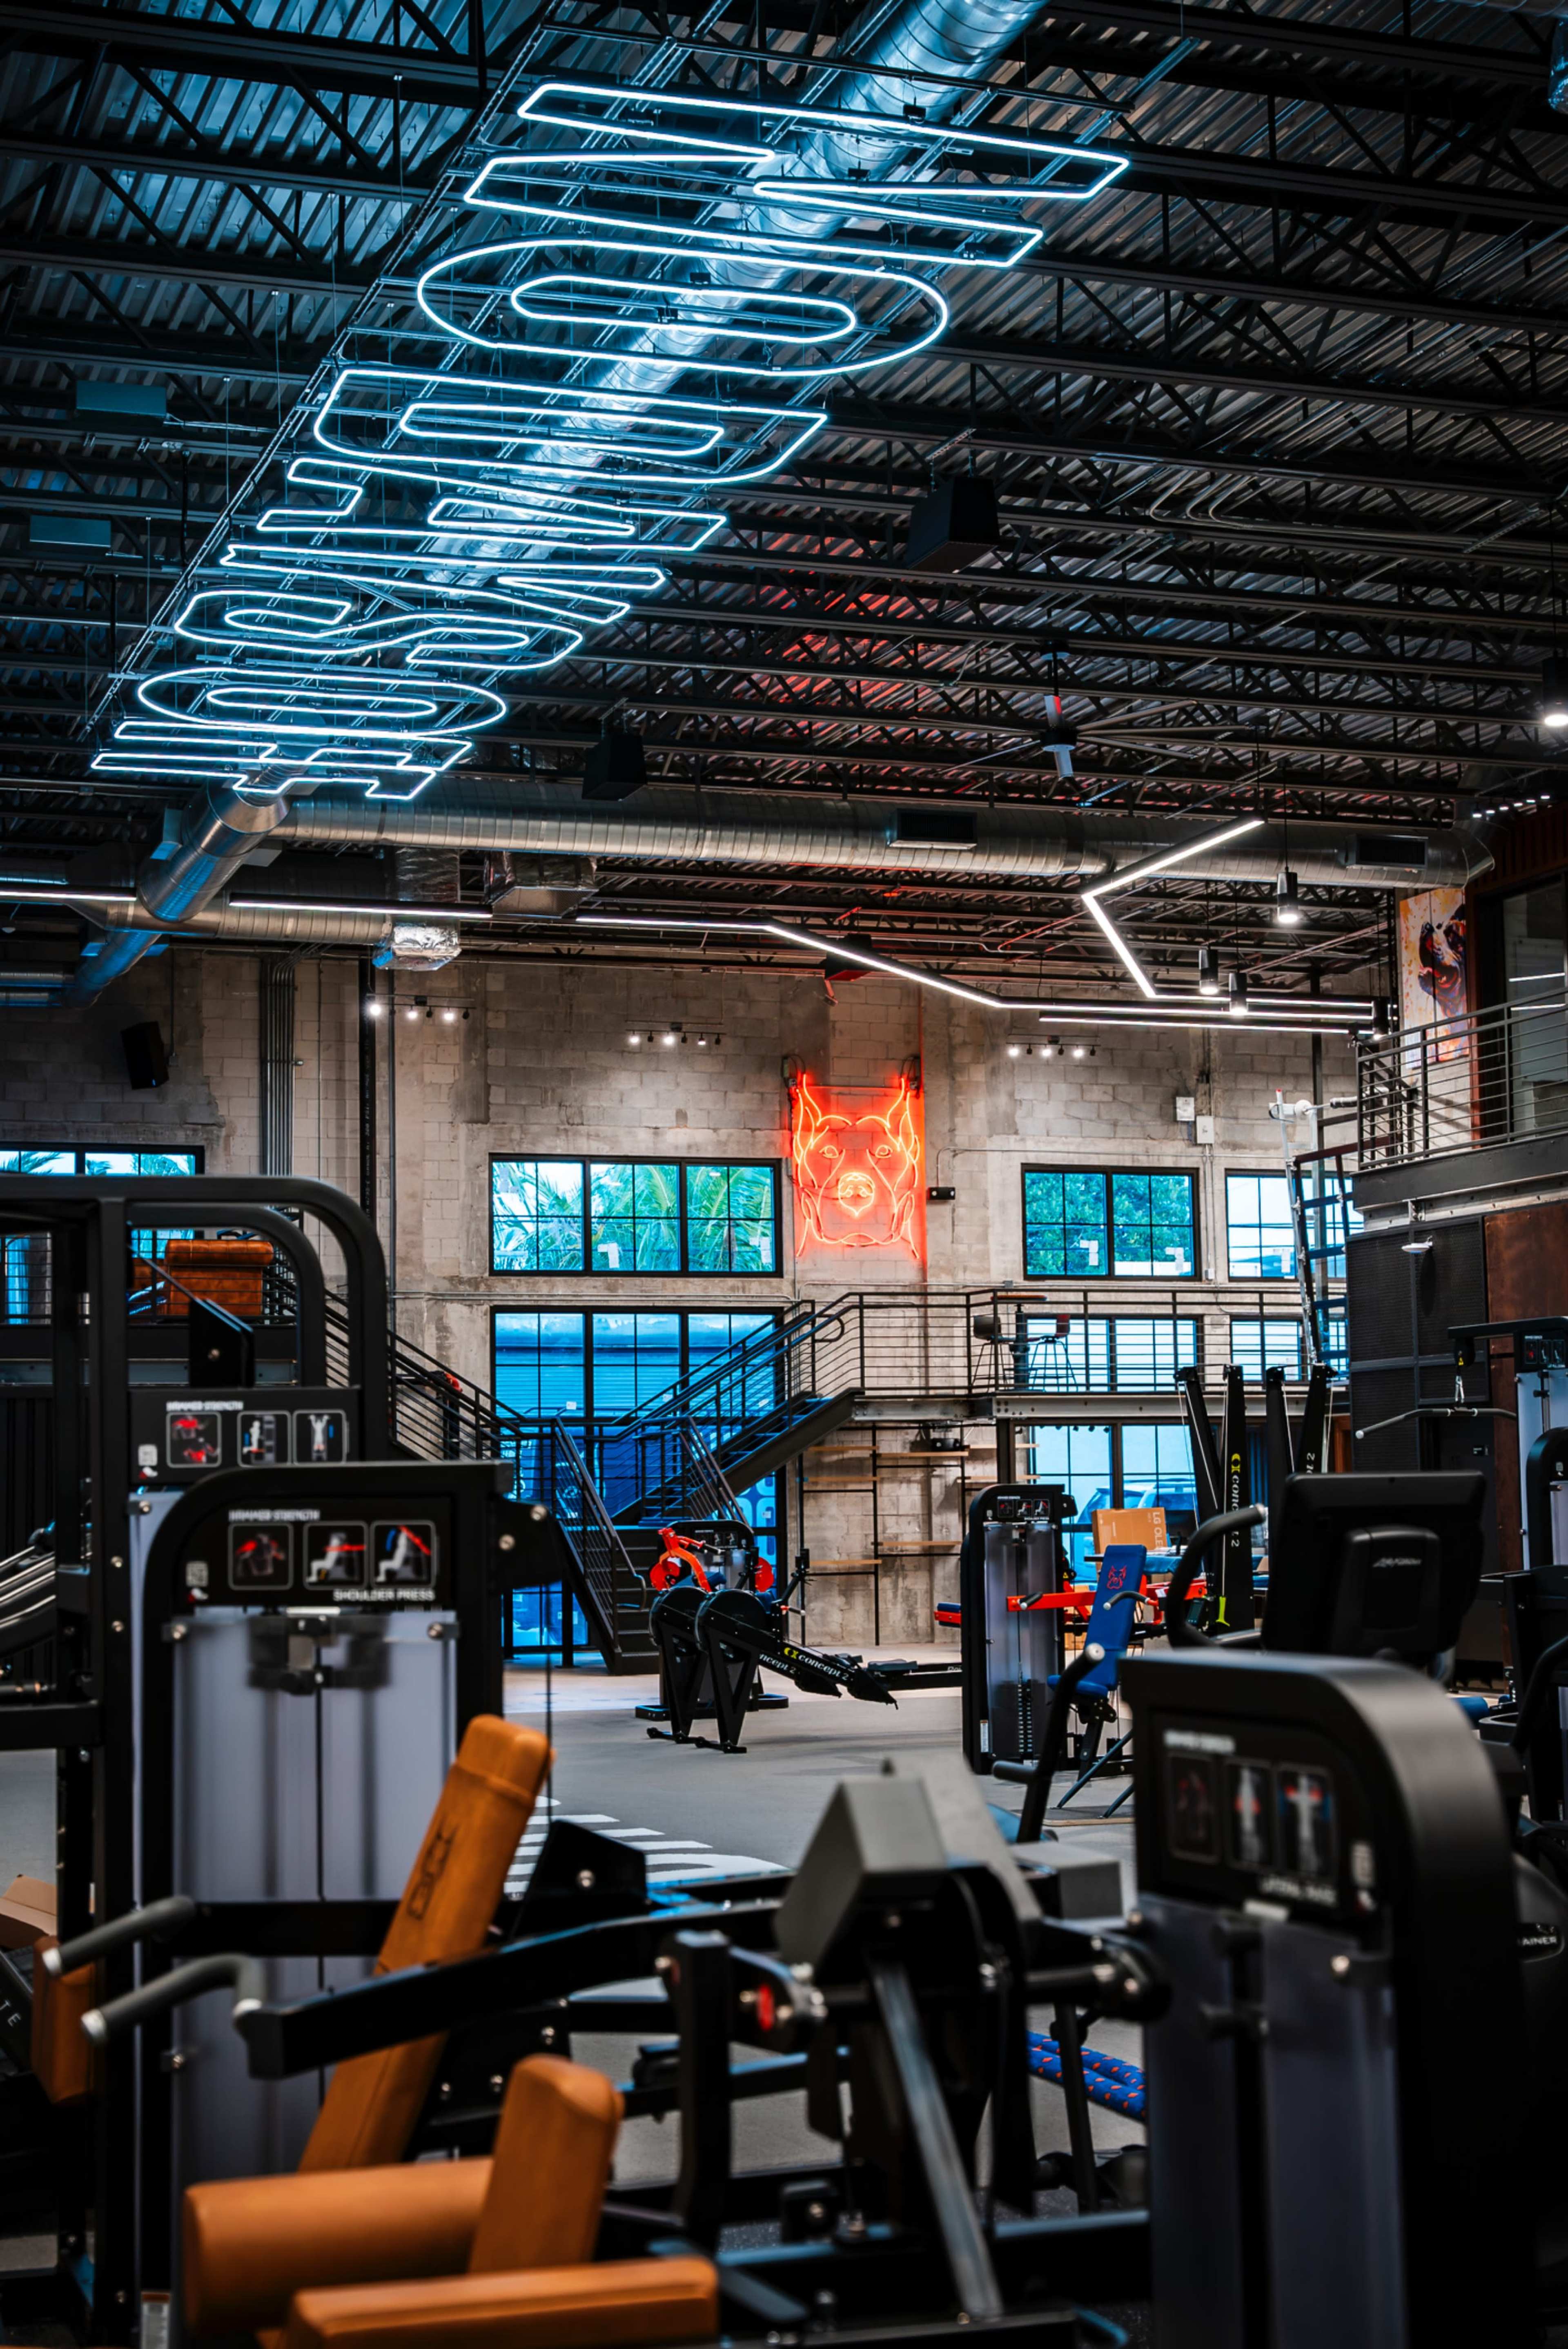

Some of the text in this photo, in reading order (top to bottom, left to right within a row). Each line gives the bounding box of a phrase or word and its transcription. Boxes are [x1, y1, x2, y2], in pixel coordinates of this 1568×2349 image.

[91, 81, 1130, 801] NO DAYS OFF
[1307, 1452, 1315, 1461] 2
[1153, 1512, 1161, 1524] LG
[1231, 1539, 1240, 1548] 2
[396, 1589, 435, 1602] PRESS
[759, 1653, 789, 1671] ncept
[798, 1654, 849, 1681] concept 2
[1521, 1935, 1557, 1946] AINER
